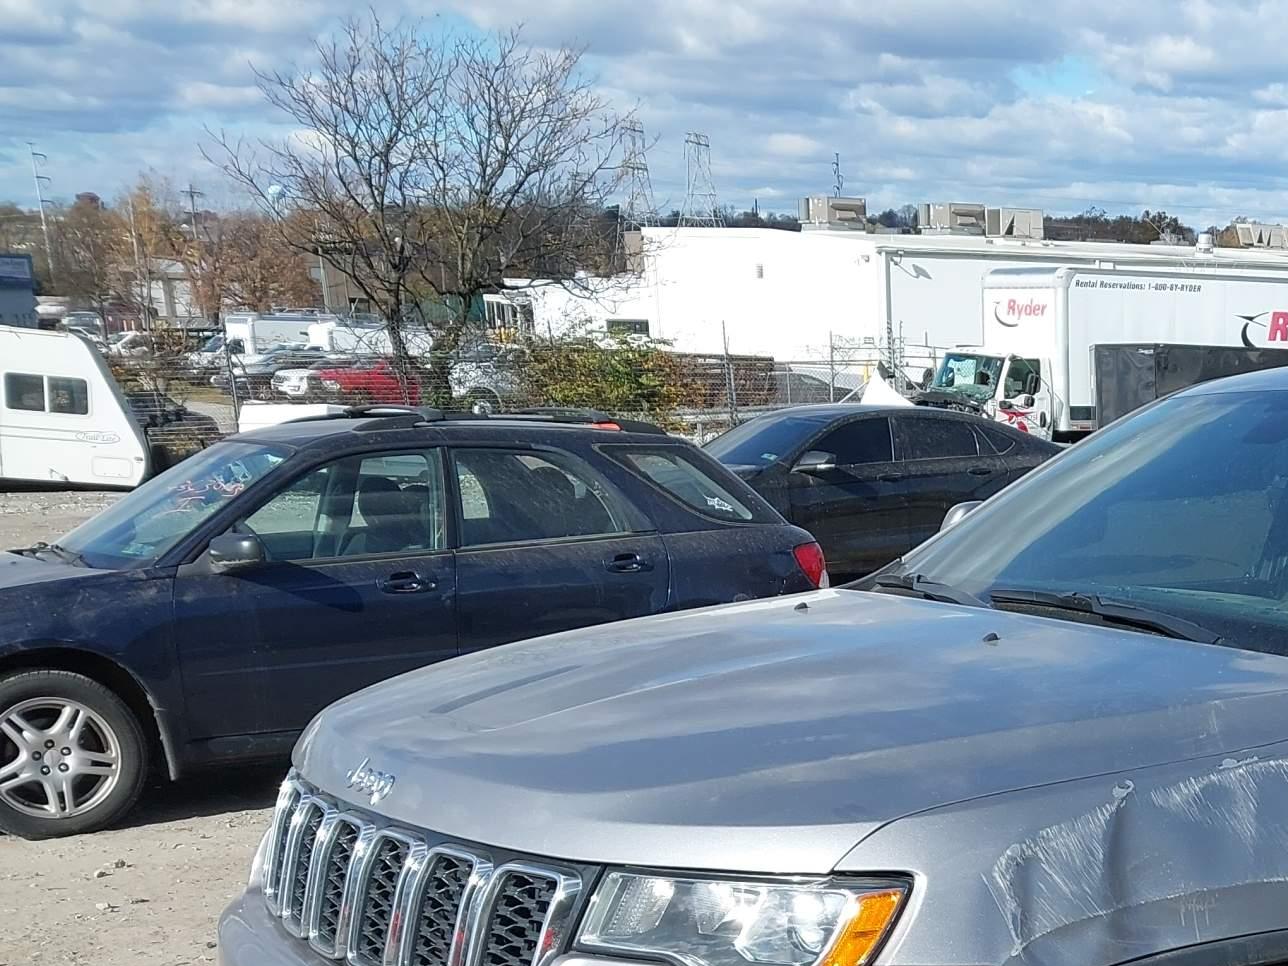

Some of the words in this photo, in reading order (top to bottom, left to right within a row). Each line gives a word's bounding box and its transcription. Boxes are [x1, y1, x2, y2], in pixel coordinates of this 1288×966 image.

[1075, 280, 1098, 288] Rental
[1100, 280, 1145, 290] Reservations:
[1007, 297, 1047, 320] Ryder
[346, 757, 395, 806] Jeep
